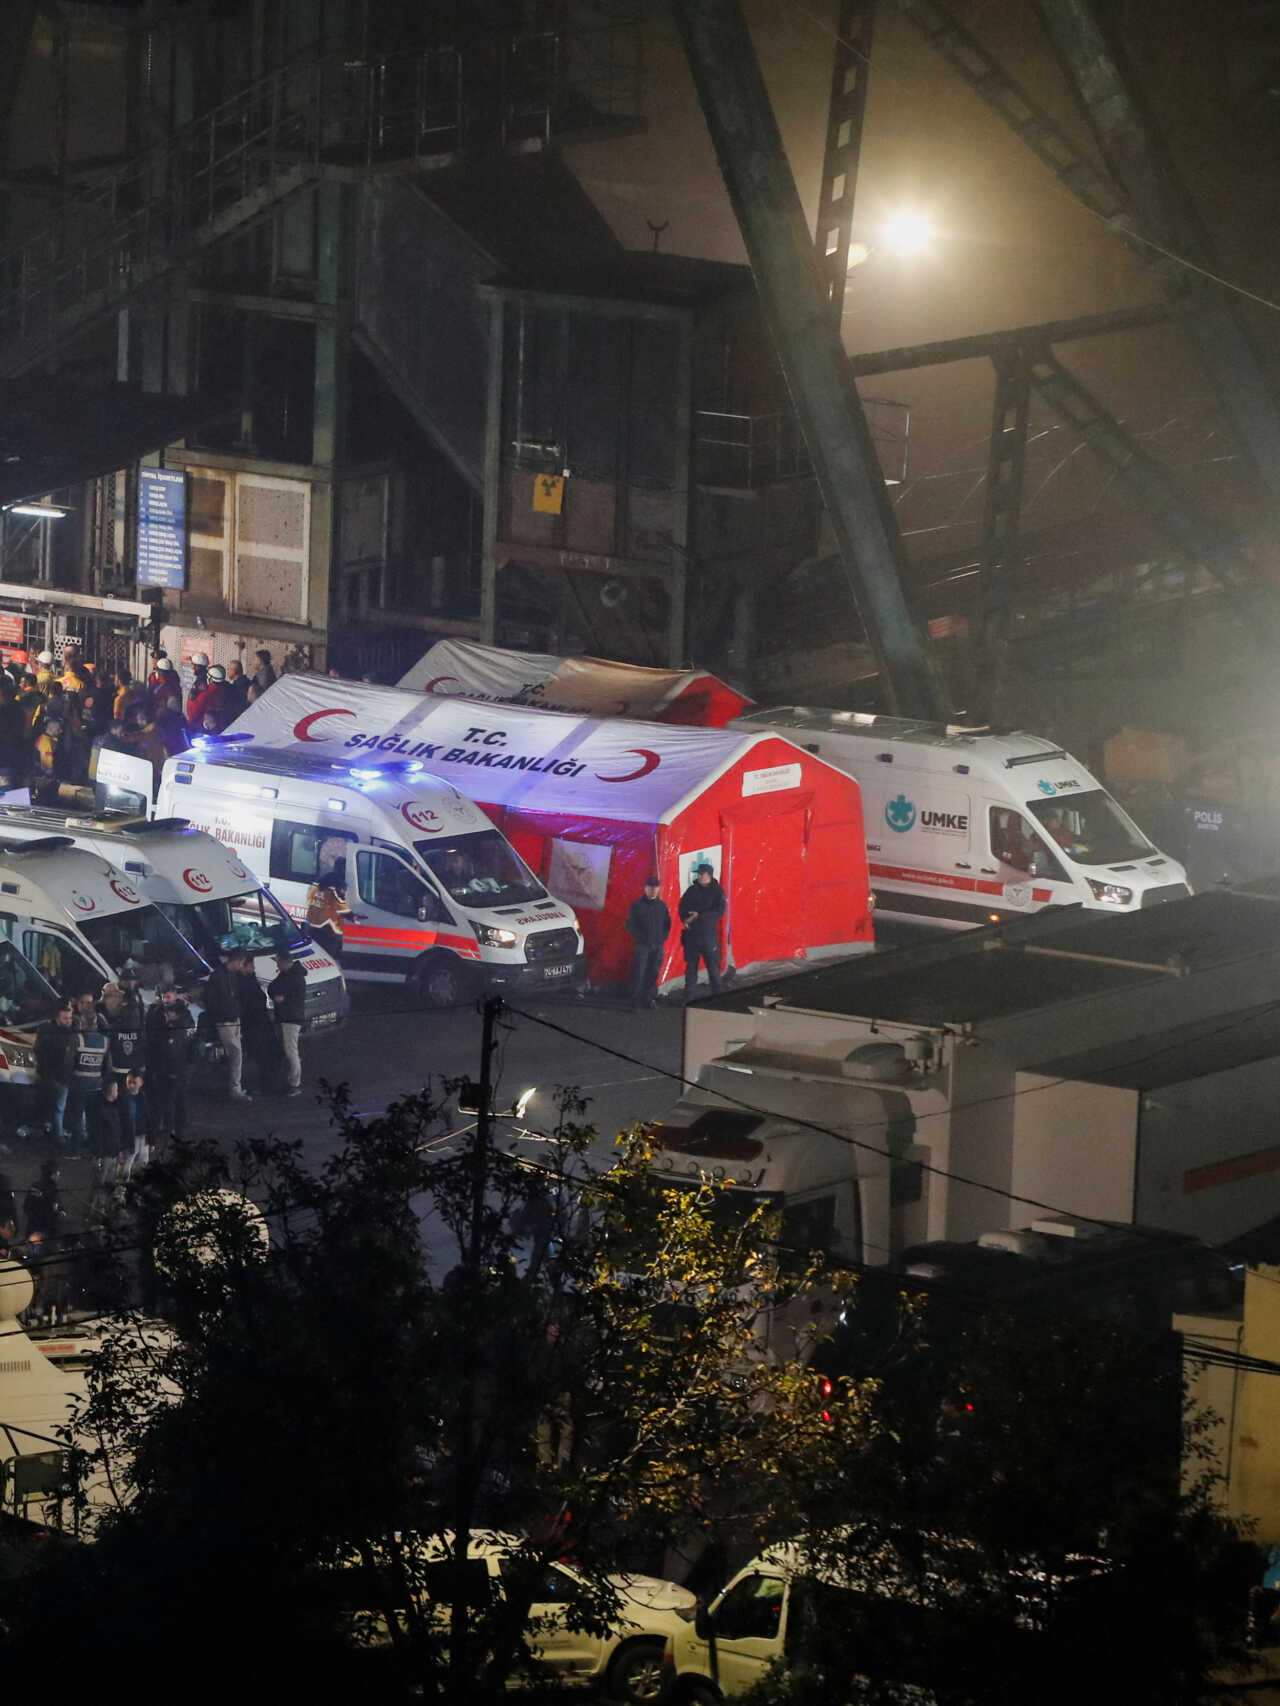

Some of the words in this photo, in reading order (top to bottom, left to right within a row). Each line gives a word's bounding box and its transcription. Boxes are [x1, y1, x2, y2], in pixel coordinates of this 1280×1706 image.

[463, 727, 508, 746] T.C.
[344, 732, 444, 759] SAĞLIK
[441, 747, 587, 777] BAKANLIĞI
[1054, 779, 1080, 790] UMKE
[412, 809, 438, 822] 112
[921, 811, 968, 829] UMKE
[191, 873, 210, 887] 112
